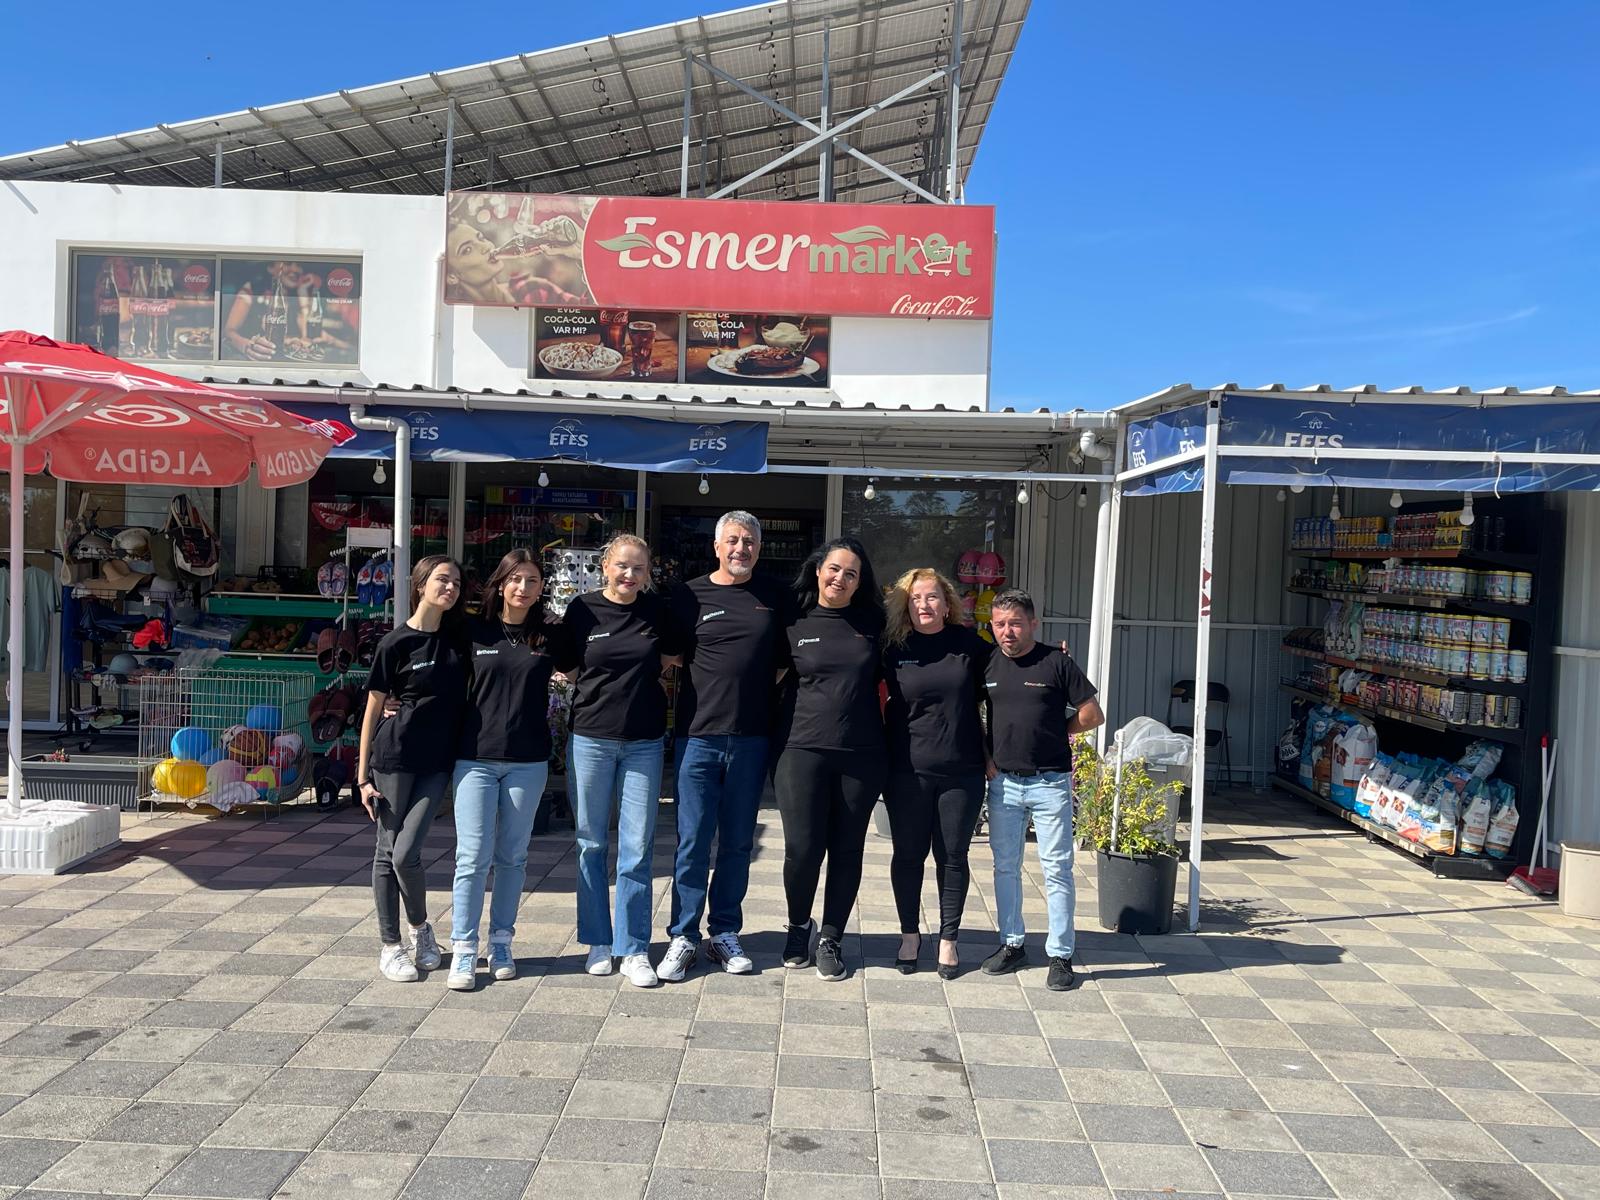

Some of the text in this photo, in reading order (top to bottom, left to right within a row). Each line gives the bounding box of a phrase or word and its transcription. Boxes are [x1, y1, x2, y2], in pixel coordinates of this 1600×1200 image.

[618, 216, 973, 277] Esmer market
[543, 315, 596, 325] COCA-COLA
[692, 320, 745, 329] COCA-COLA
[552, 326, 588, 335] VAR MI?
[701, 331, 736, 340] VAR MI?
[411, 426, 439, 441] FES
[549, 431, 589, 449] EFES
[689, 436, 727, 452] EFES
